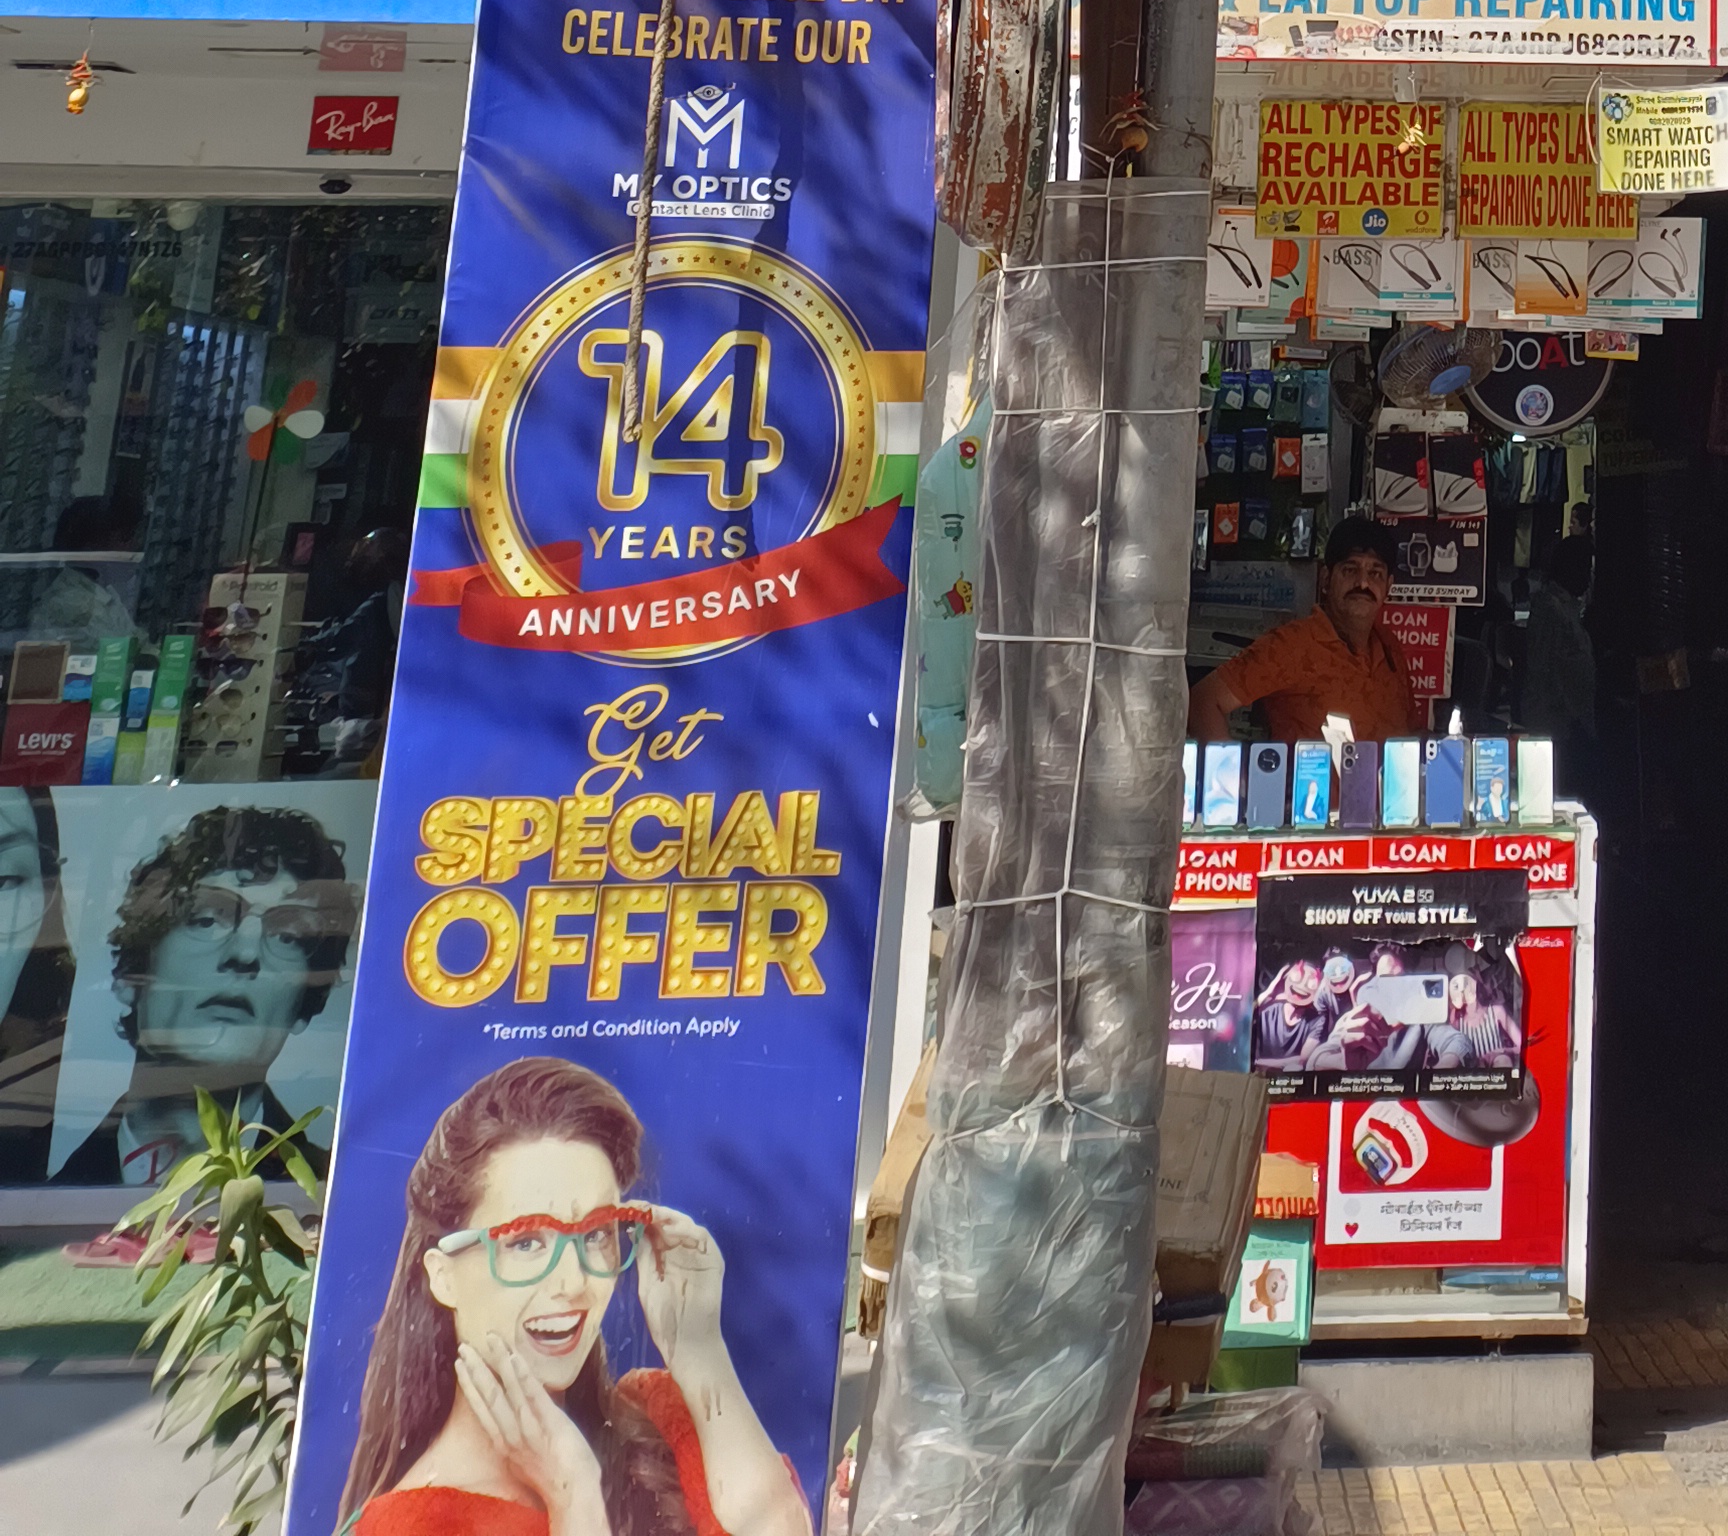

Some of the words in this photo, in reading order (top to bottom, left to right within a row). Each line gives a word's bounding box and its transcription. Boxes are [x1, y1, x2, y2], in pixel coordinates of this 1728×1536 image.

[561, 9, 779, 62] CELEBRATE
[793, 19, 871, 64] OUR
[1266, 104, 1312, 135] ALL
[1321, 104, 1400, 136] TYPES
[1463, 111, 1496, 163] ALL
[1502, 113, 1559, 164] TYPES
[1607, 127, 1662, 147] SMART
[1668, 123, 1728, 146] WATCH
[1261, 141, 1441, 178] RECHARGE
[1624, 148, 1710, 169] REPAIRING
[672, 175, 792, 201] OPTICS
[1621, 172, 1665, 191] DONE
[1671, 170, 1715, 189] HERE
[1260, 182, 1439, 206] AVAILABLE
[1460, 175, 1542, 226] REPAIRING
[1547, 176, 1591, 227] DONE
[693, 204, 726, 216] Lens
[732, 205, 772, 217] Clinic
[1364, 216, 1387, 228] Jio
[578, 329, 785, 513] 14
[587, 526, 748, 560] YEARS
[518, 568, 801, 638] ANNIVERSARY
[575, 683, 724, 801] Get
[413, 790, 842, 886] SPECIAL
[1286, 847, 1344, 868] LOAN
[1389, 842, 1447, 862] LOAN
[1495, 841, 1552, 861] LOAN
[1185, 872, 1253, 893] PHONE
[1352, 887, 1401, 904] YUVA
[1305, 907, 1350, 925] SHOW
[1352, 907, 1382, 925] OFF
[403, 880, 829, 1009] OFFER
[551, 1020, 587, 1039] and
[592, 1018, 682, 1038] Condition
[685, 1016, 740, 1038] Apply
